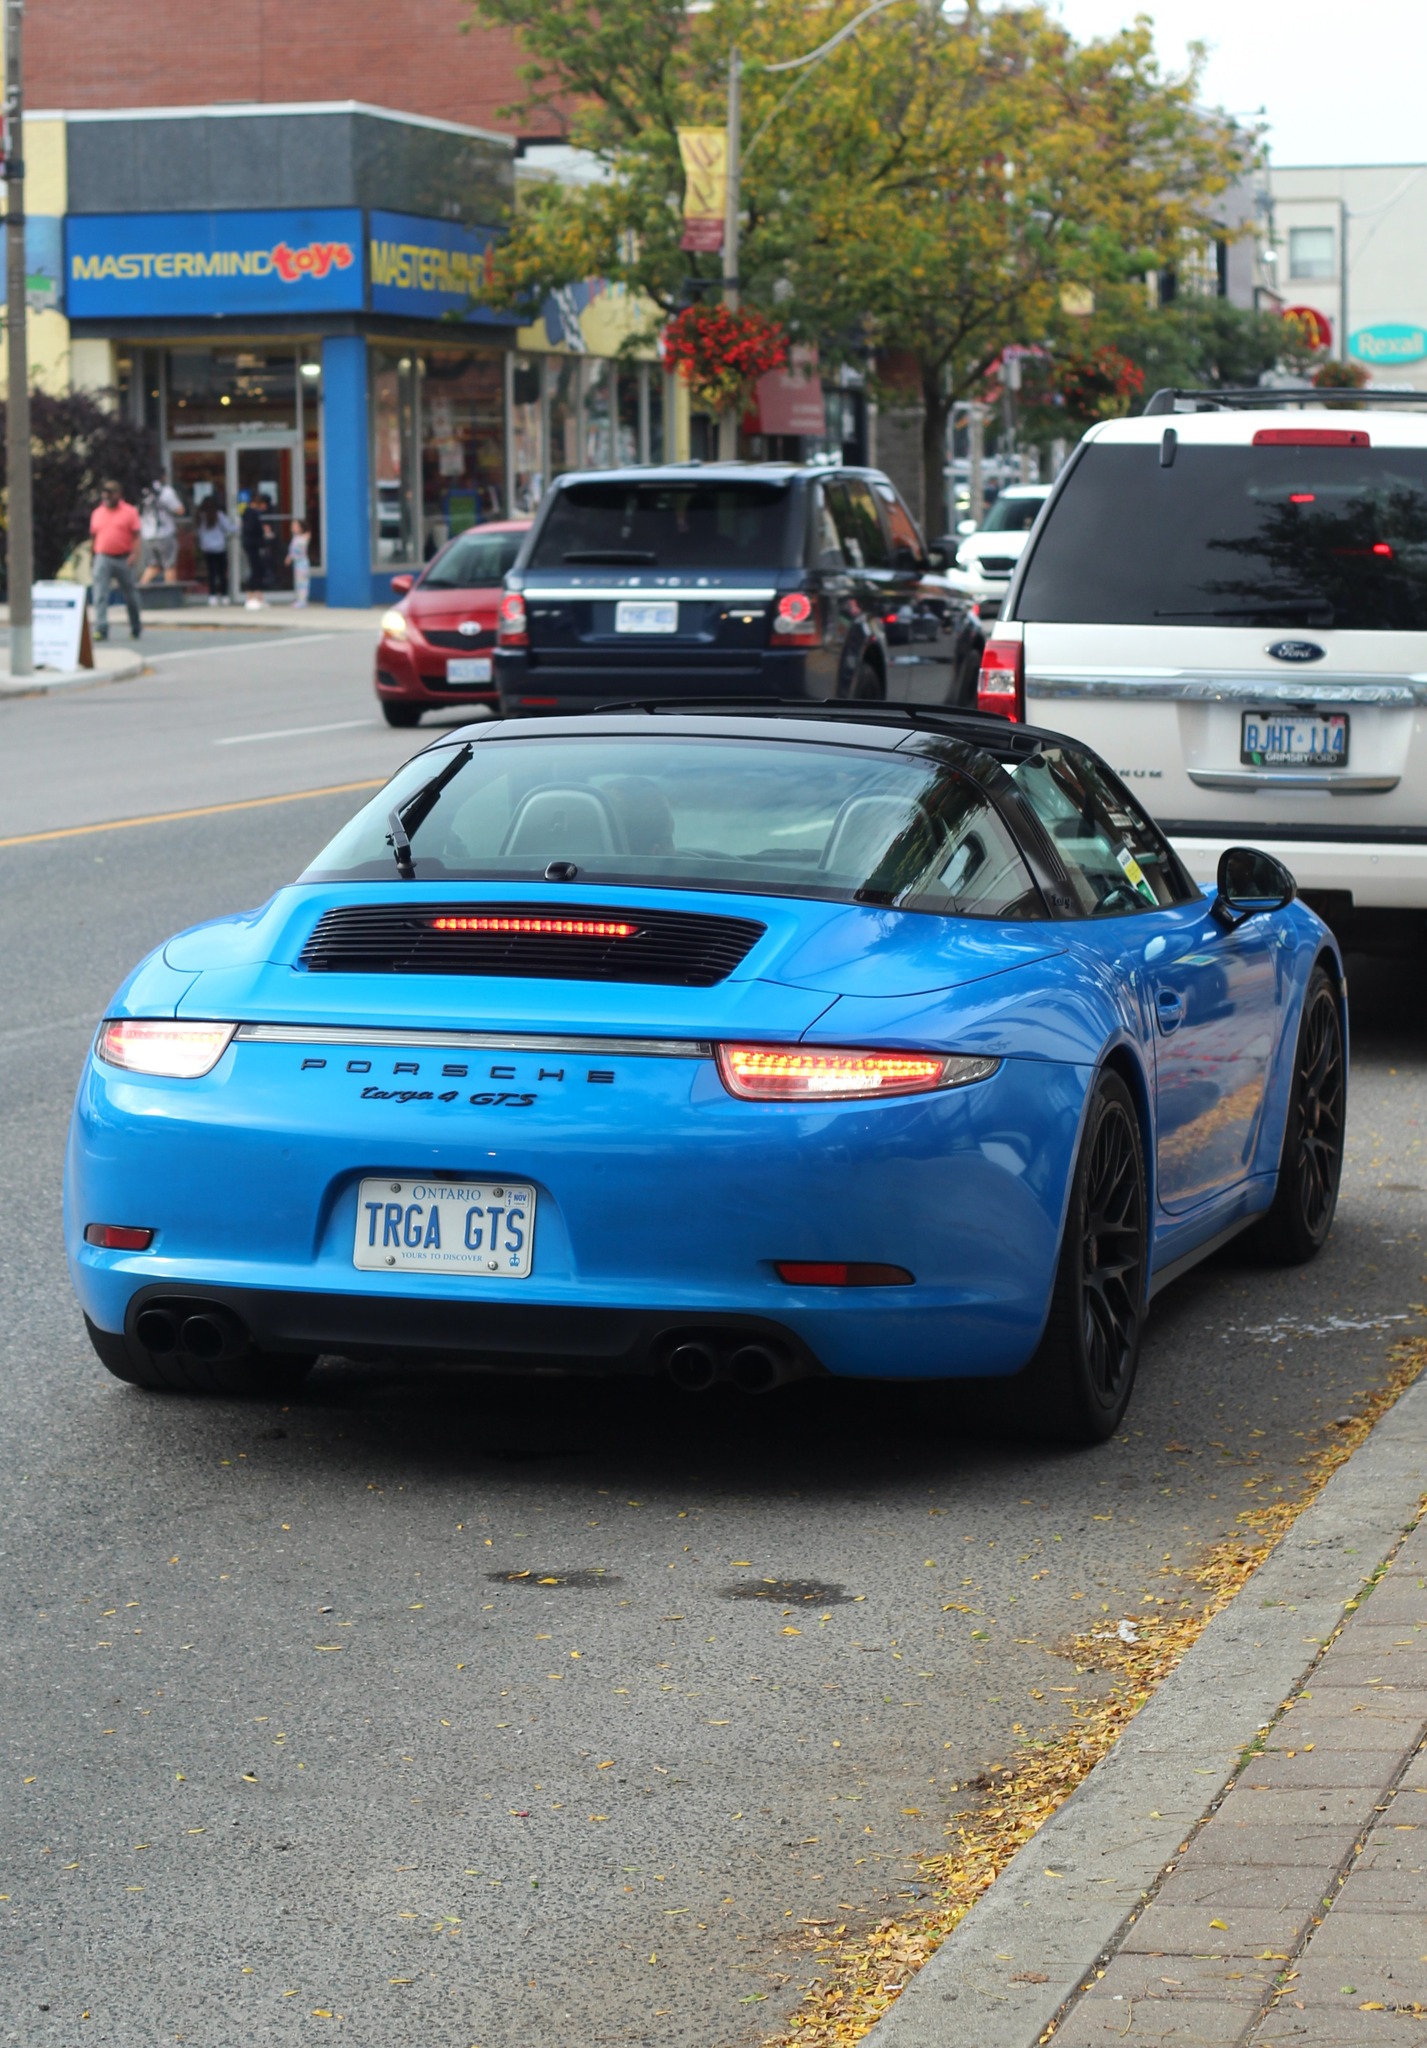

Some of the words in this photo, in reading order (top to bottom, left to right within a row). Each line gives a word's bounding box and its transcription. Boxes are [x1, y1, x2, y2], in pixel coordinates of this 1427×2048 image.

[1358, 331, 1424, 357] Rexall
[1278, 643, 1312, 659] Ford
[300, 1058, 615, 1084] PORSCHE
[360, 1086, 434, 1103] targa
[437, 1089, 460, 1103] 4
[469, 1092, 538, 1107] GTS
[412, 1185, 482, 1202] ONTARIO
[513, 1194, 527, 1202] NOV
[364, 1201, 441, 1249] TRGA
[464, 1206, 525, 1252] GTS
[401, 1251, 427, 1260] YOURS
[443, 1253, 483, 1262] DISCOVER
